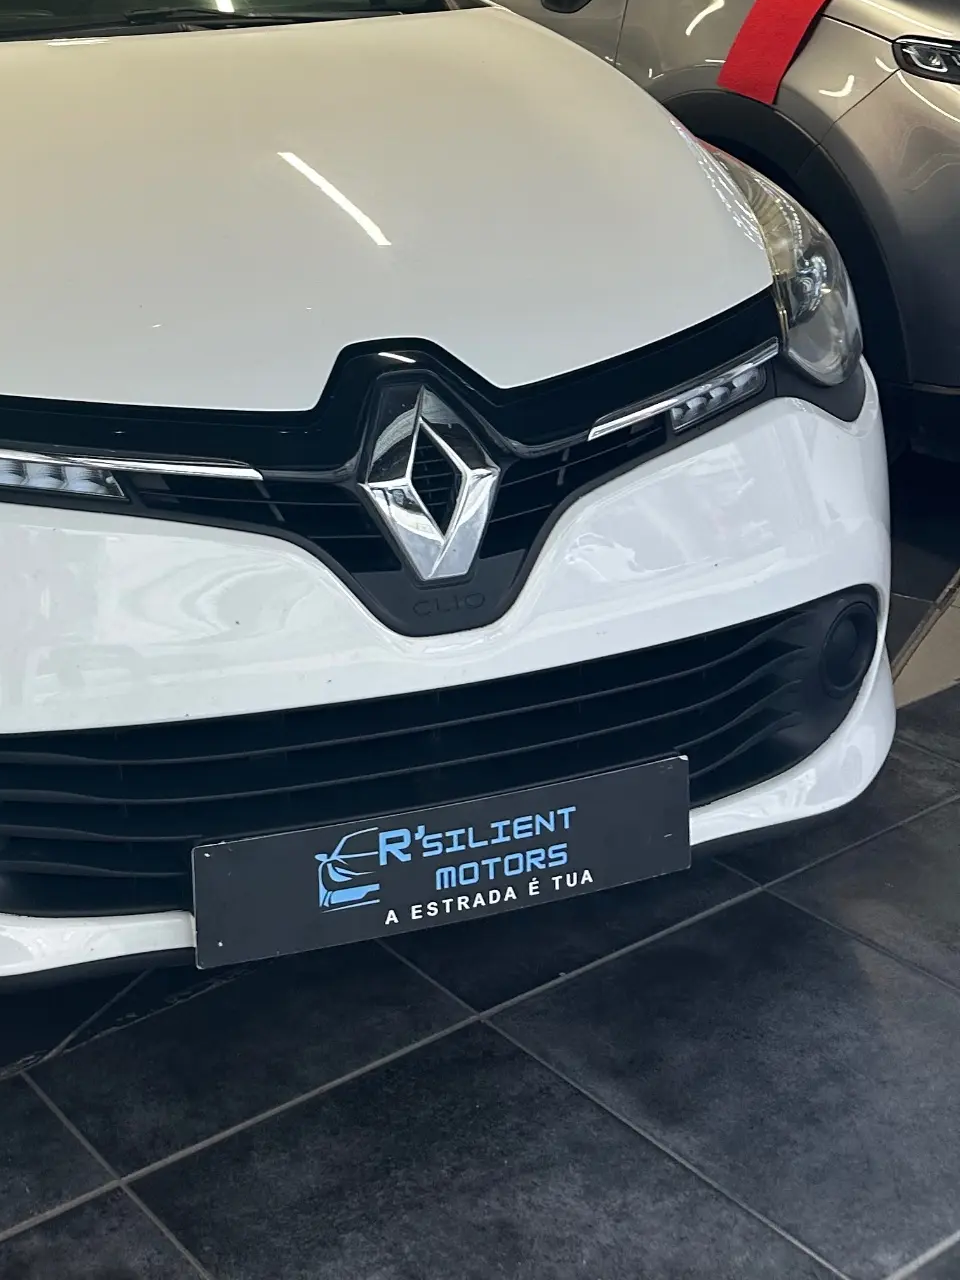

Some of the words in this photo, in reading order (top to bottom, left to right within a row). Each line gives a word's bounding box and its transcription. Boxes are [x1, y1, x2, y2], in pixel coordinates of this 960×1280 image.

[412, 592, 486, 617] CLIO
[378, 805, 577, 866] R'SILIENT
[435, 842, 569, 890] MOTORS
[384, 909, 399, 925] A
[411, 886, 517, 920] ESTRADA
[528, 877, 540, 896] É
[551, 869, 594, 891] TUA
